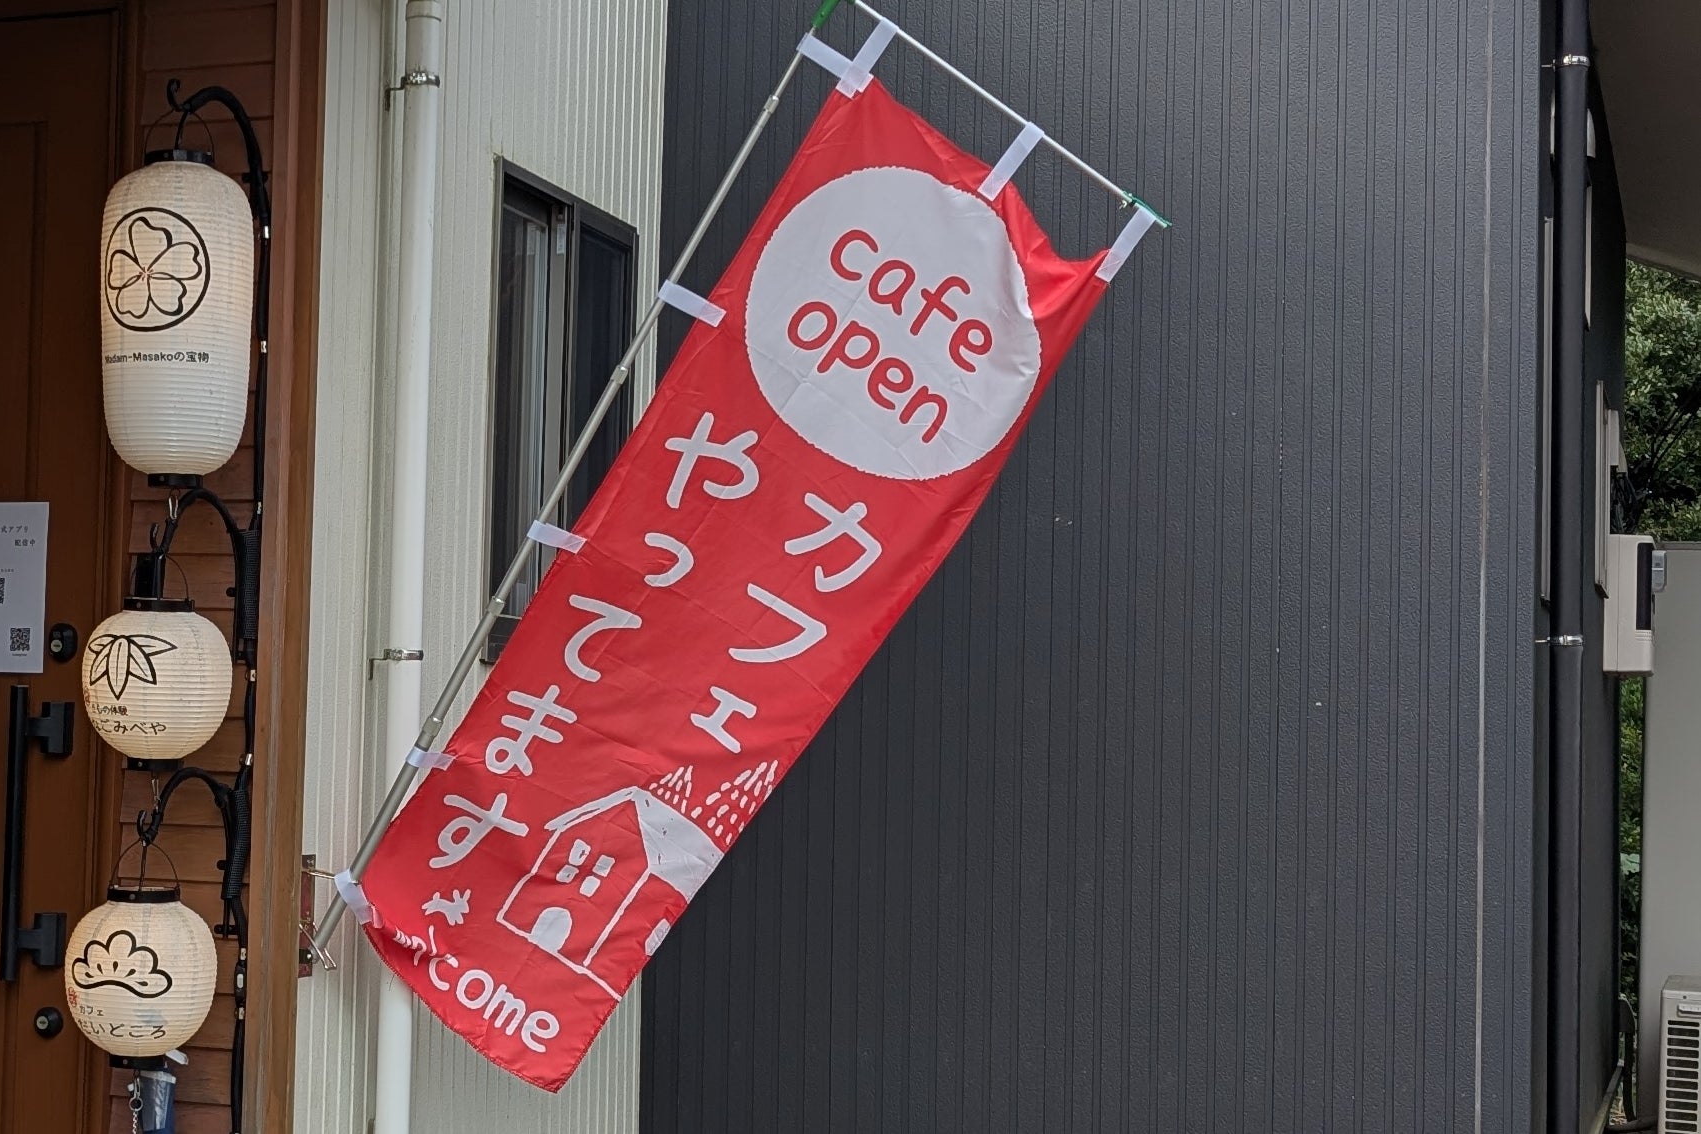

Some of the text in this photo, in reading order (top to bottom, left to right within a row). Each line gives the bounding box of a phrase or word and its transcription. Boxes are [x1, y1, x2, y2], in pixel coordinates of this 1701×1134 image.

[787, 301, 948, 443] open
[830, 229, 993, 373] cafe
[428, 411, 760, 869] やってます
[690, 492, 883, 754] カフェ
